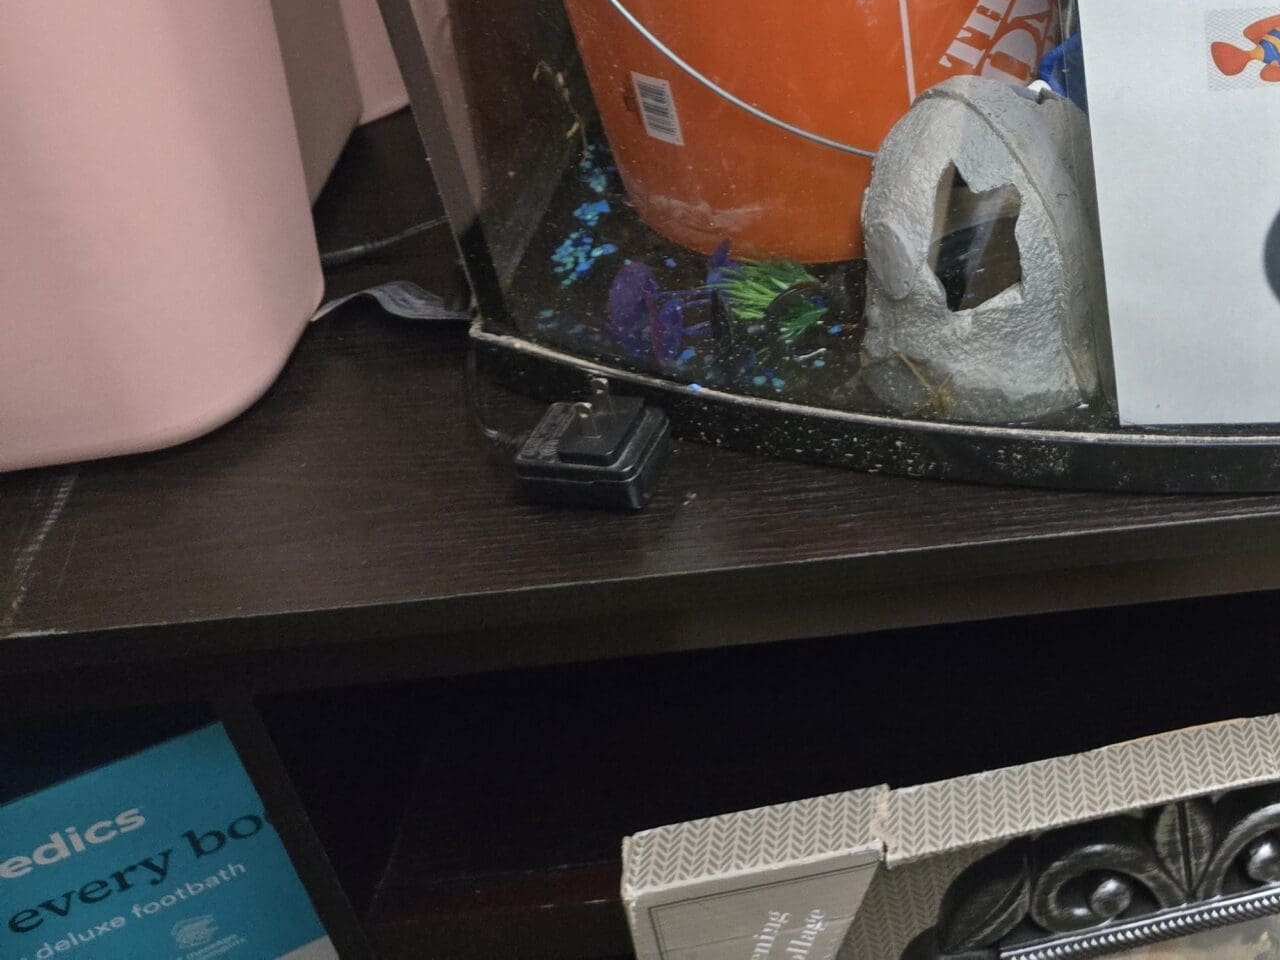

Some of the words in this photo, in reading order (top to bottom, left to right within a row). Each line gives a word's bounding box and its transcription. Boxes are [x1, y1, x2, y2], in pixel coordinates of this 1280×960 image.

[8, 849, 173, 933] every
[36, 915, 126, 960] deluxe
[131, 861, 247, 919] footbath
